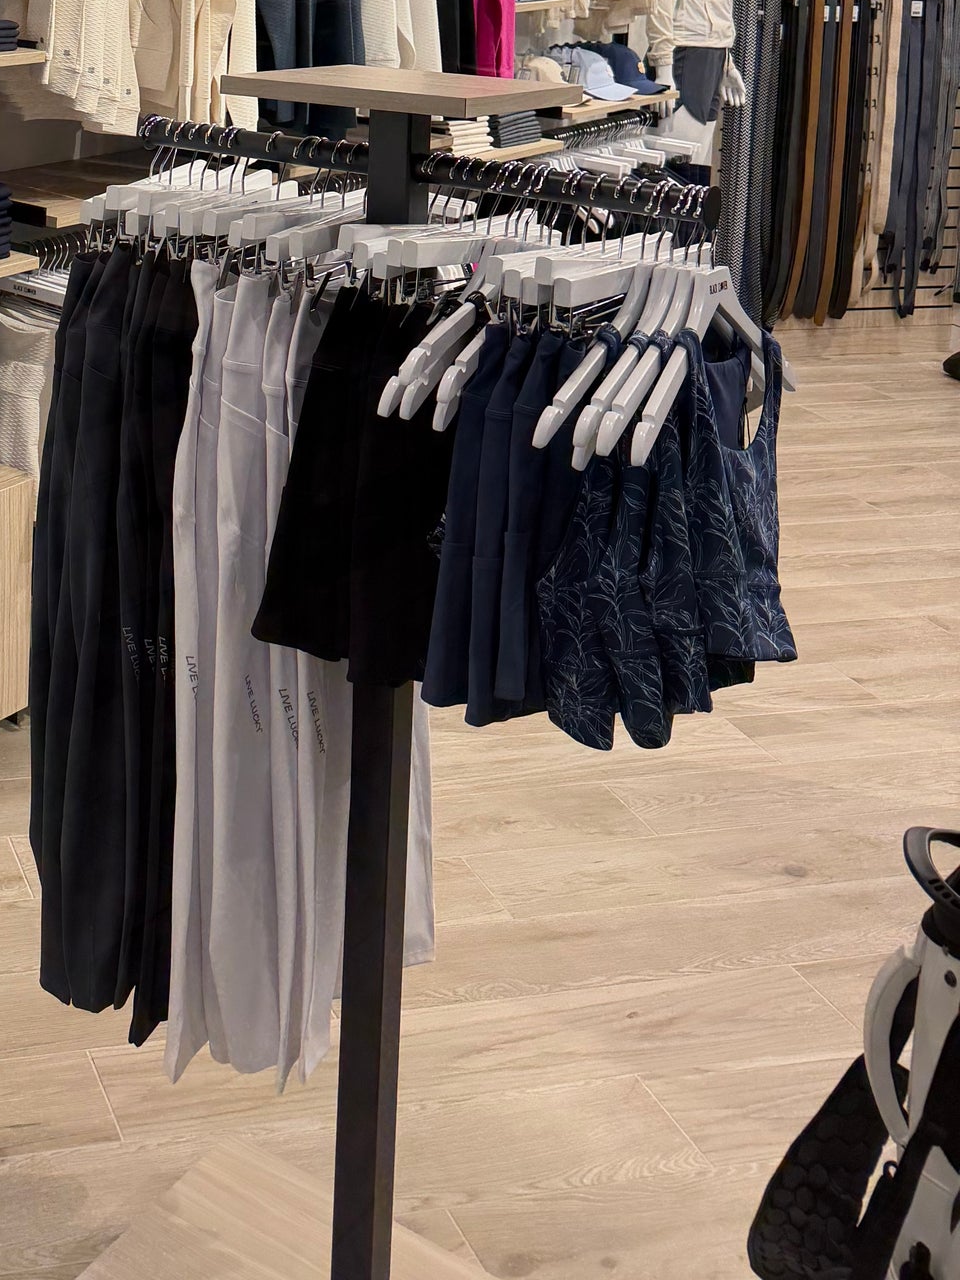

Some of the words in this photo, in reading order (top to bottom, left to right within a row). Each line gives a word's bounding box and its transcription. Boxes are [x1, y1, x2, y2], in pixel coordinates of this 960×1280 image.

[122, 626, 136, 655] LIVE
[144, 639, 155, 665] LIVE
[158, 635, 169, 663] LIVE
[185, 655, 198, 683] LIVE
[244, 674, 255, 700] LIVE
[250, 699, 263, 734] LUCKY
[278, 688, 292, 715] LIVE
[307, 691, 319, 717] LIVE
[314, 718, 326, 754] LUCKY
